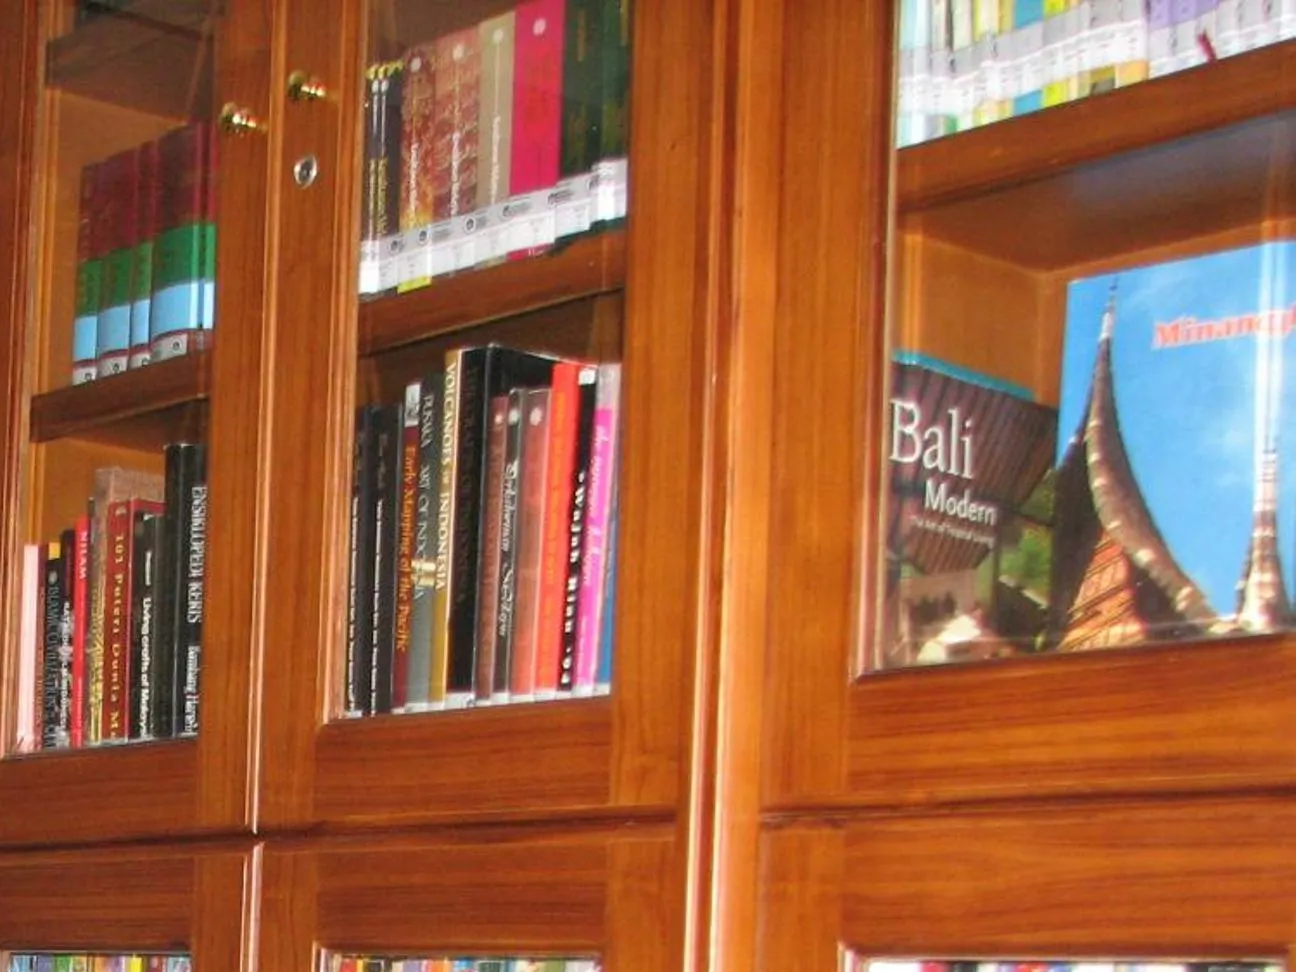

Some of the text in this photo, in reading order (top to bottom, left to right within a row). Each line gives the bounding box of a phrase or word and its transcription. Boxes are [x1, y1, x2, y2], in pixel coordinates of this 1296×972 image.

[442, 363, 456, 466] VOLCANOES
[889, 399, 973, 480] Bali
[189, 486, 207, 578] ENSIKLOPEDI
[925, 479, 996, 526] Modern
[79, 530, 89, 580] NILAM
[114, 534, 124, 564] 101
[395, 446, 417, 653] Early Mapping of the Pacific
[435, 491, 450, 591] INDONESIA
[112, 572, 123, 633] Puteri
[141, 596, 151, 636] Living
[187, 581, 204, 625] KERIS
[109, 641, 122, 703] Dunia
[140, 636, 151, 671] crafts
